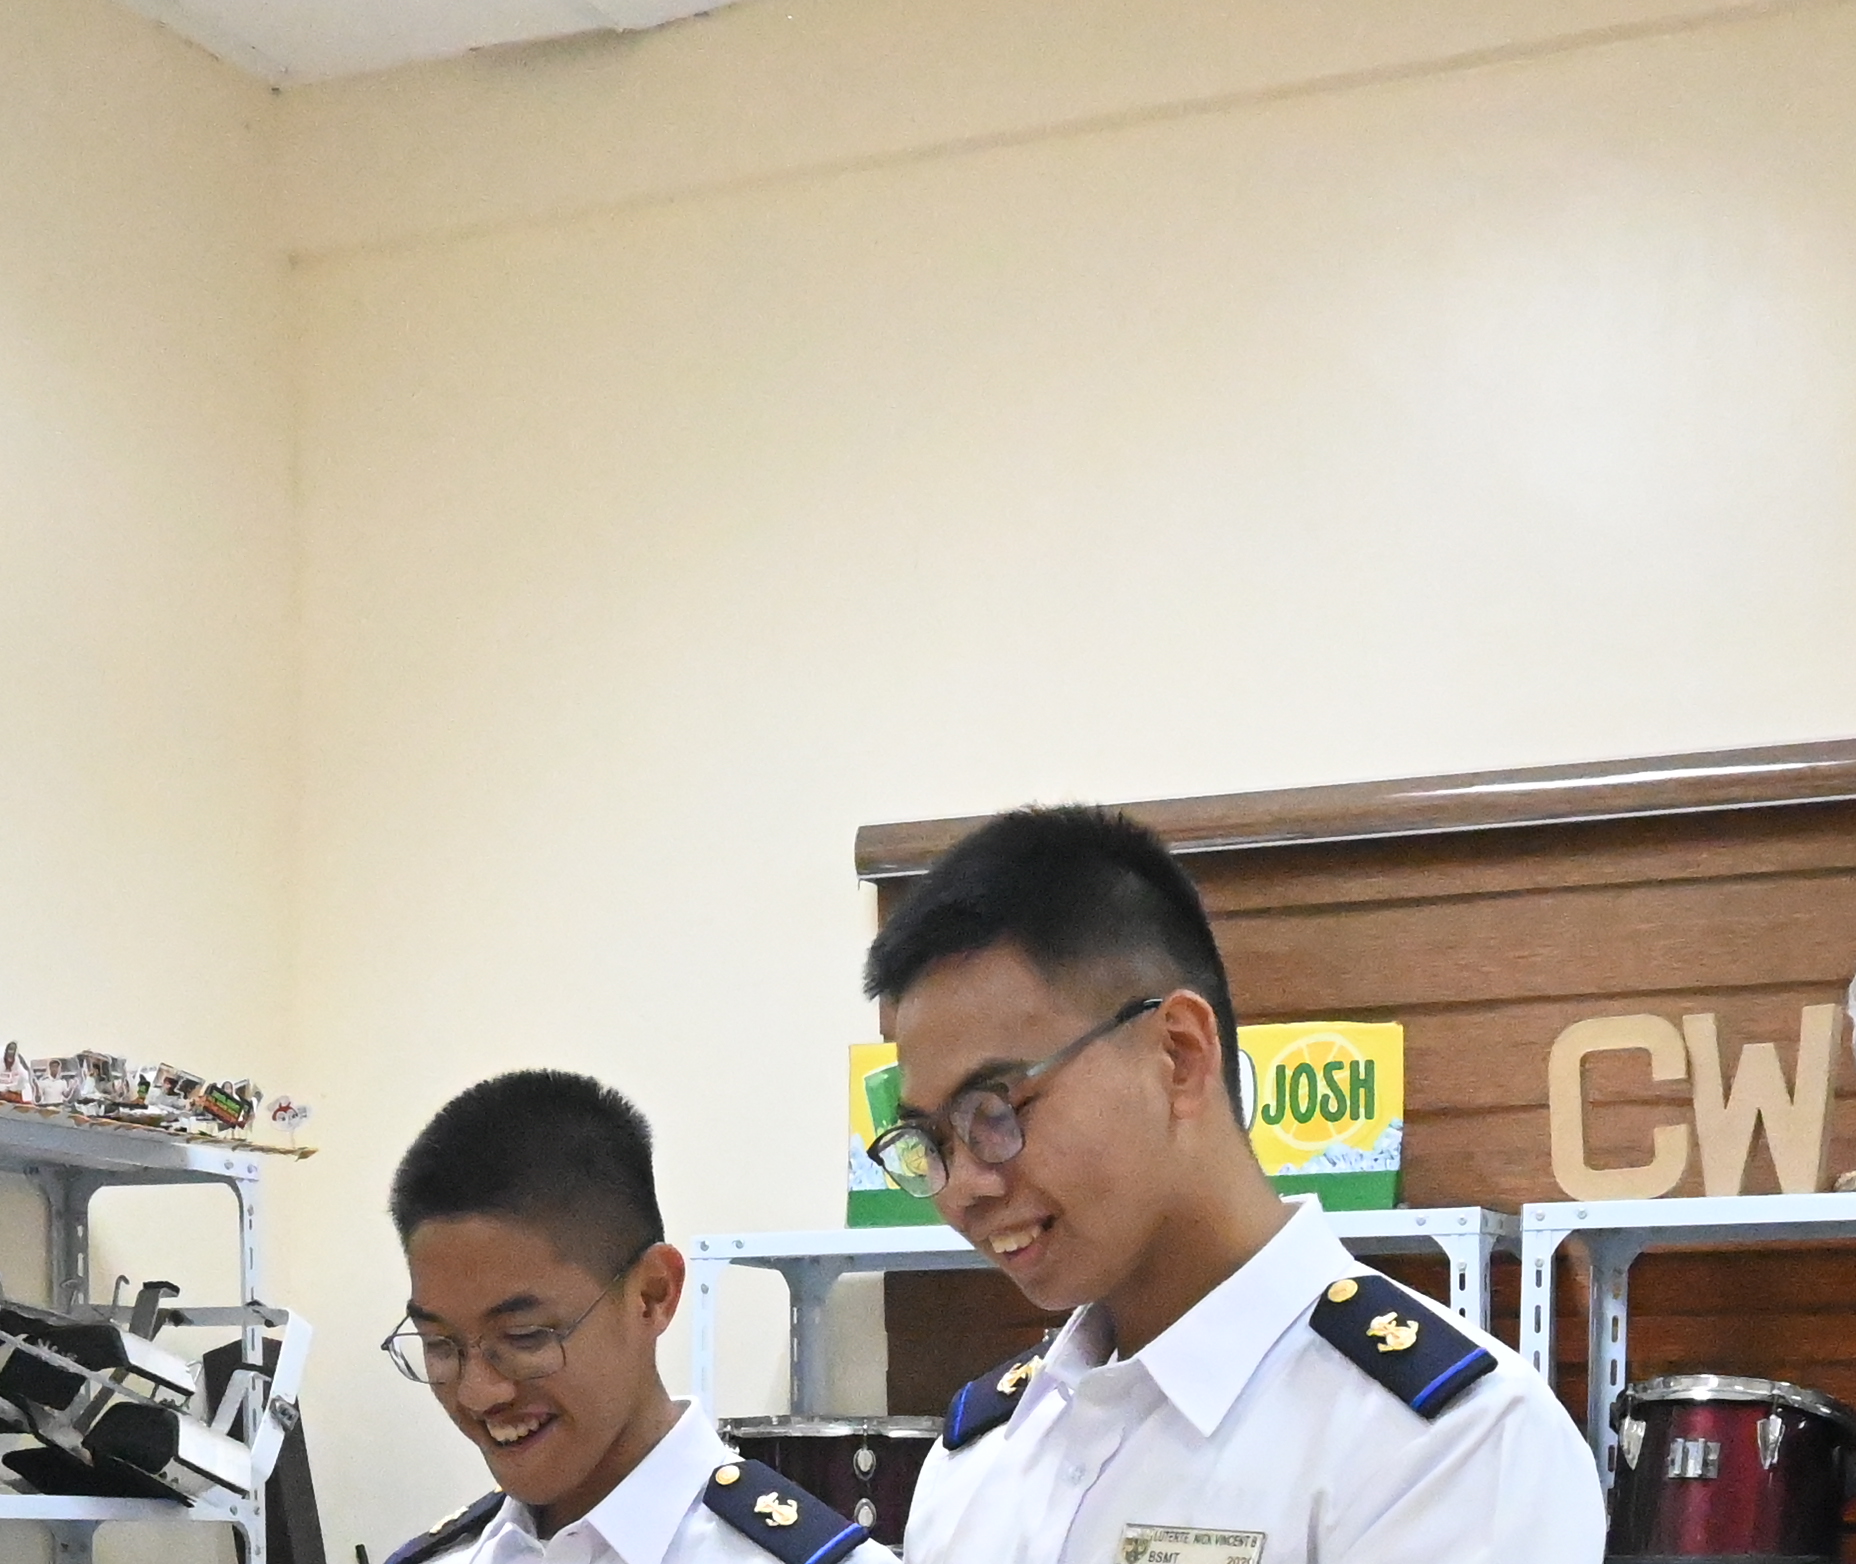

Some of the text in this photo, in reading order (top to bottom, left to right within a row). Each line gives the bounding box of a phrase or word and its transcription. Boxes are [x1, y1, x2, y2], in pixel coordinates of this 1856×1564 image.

[1261, 1060, 1375, 1125] JOSH
[1548, 1003, 1842, 1202] CW
[1148, 1551, 1180, 1564] BSMT
